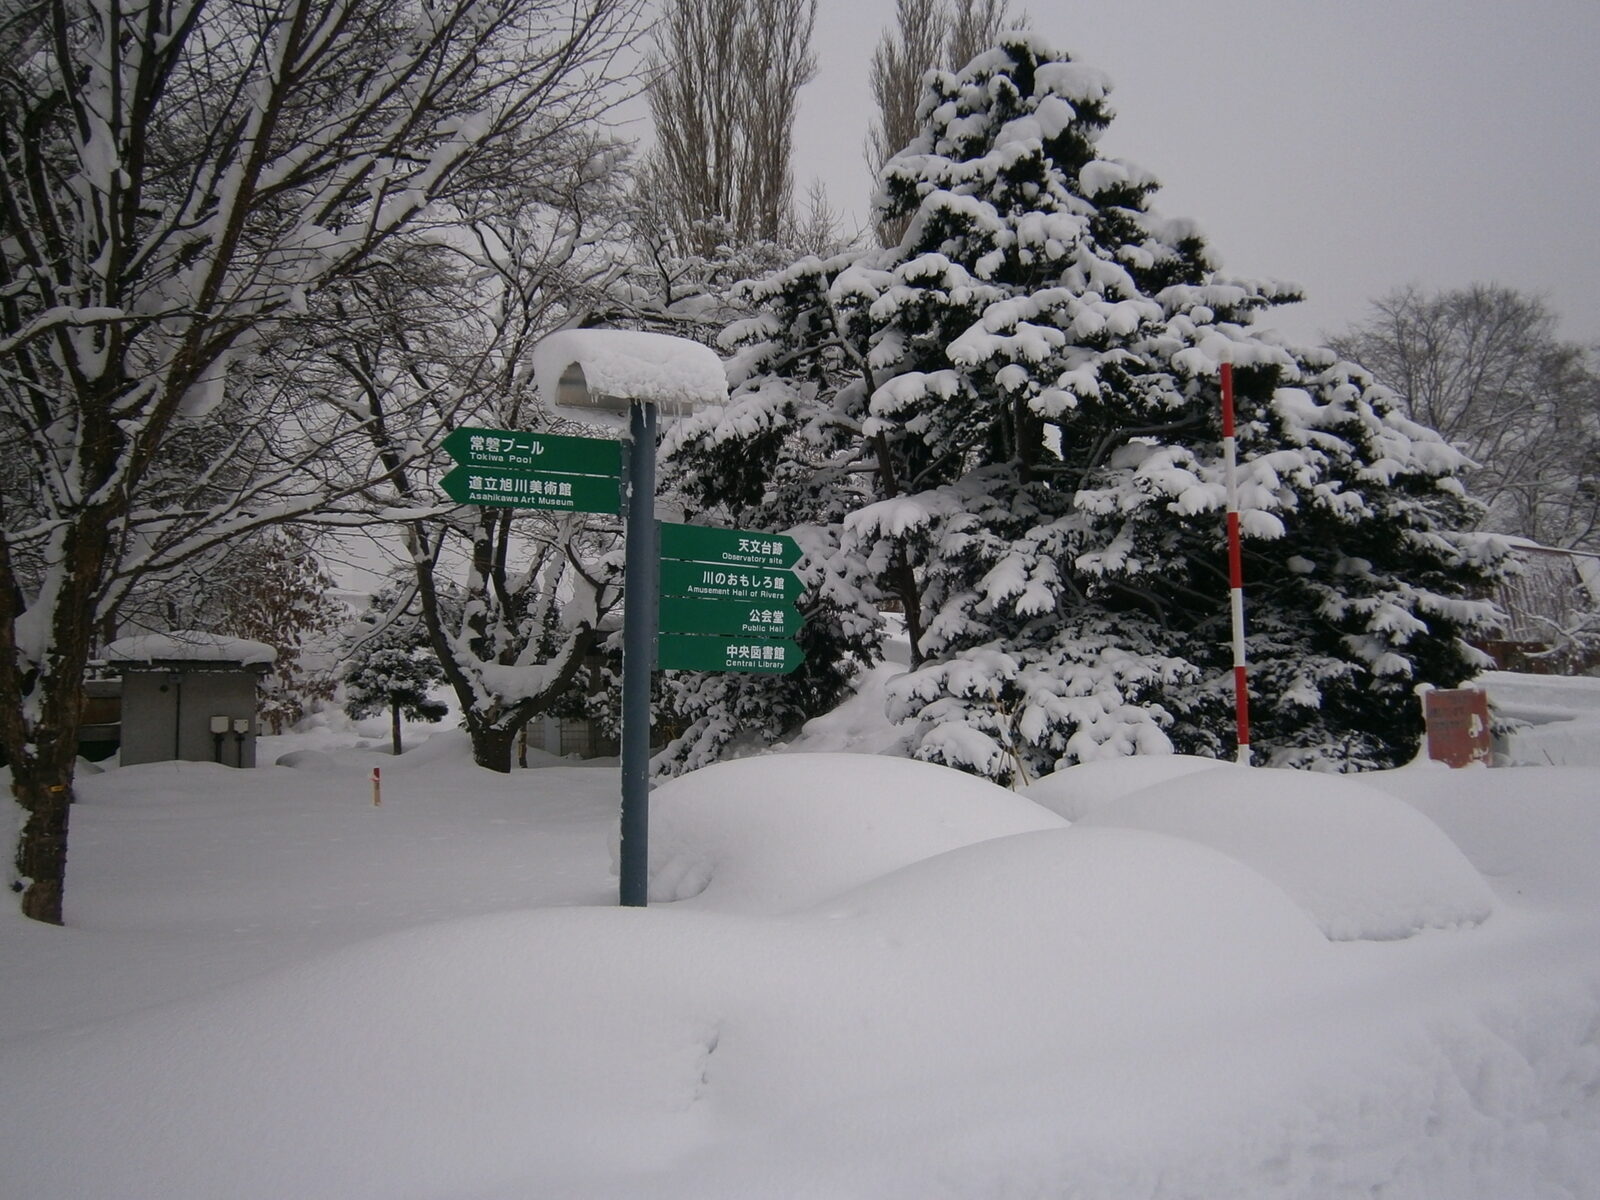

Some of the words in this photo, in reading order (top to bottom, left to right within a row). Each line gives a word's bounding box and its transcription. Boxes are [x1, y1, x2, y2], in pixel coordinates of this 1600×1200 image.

[470, 435, 544, 455] 常磐プール
[470, 452, 504, 462] Tokiwa
[509, 454, 532, 464] Pool
[469, 475, 572, 497] 道立旭川美術館
[469, 492, 519, 503] Asahikawa
[520, 496, 536, 504] Art
[538, 497, 574, 507] Museum
[738, 538, 783, 555] 天文台跡
[722, 552, 766, 564] Observatory
[769, 557, 783, 565] site
[703, 570, 785, 590] 川のおもしろ館
[687, 585, 730, 596] Amusement
[732, 588, 748, 597] Hall
[760, 590, 785, 599] Rivers
[749, 608, 784, 624] 公会堂
[742, 624, 766, 632] Public
[769, 625, 784, 633] Hall
[726, 644, 785, 660] 中央図書館
[726, 659, 756, 667] Central
[758, 660, 785, 669] Library
